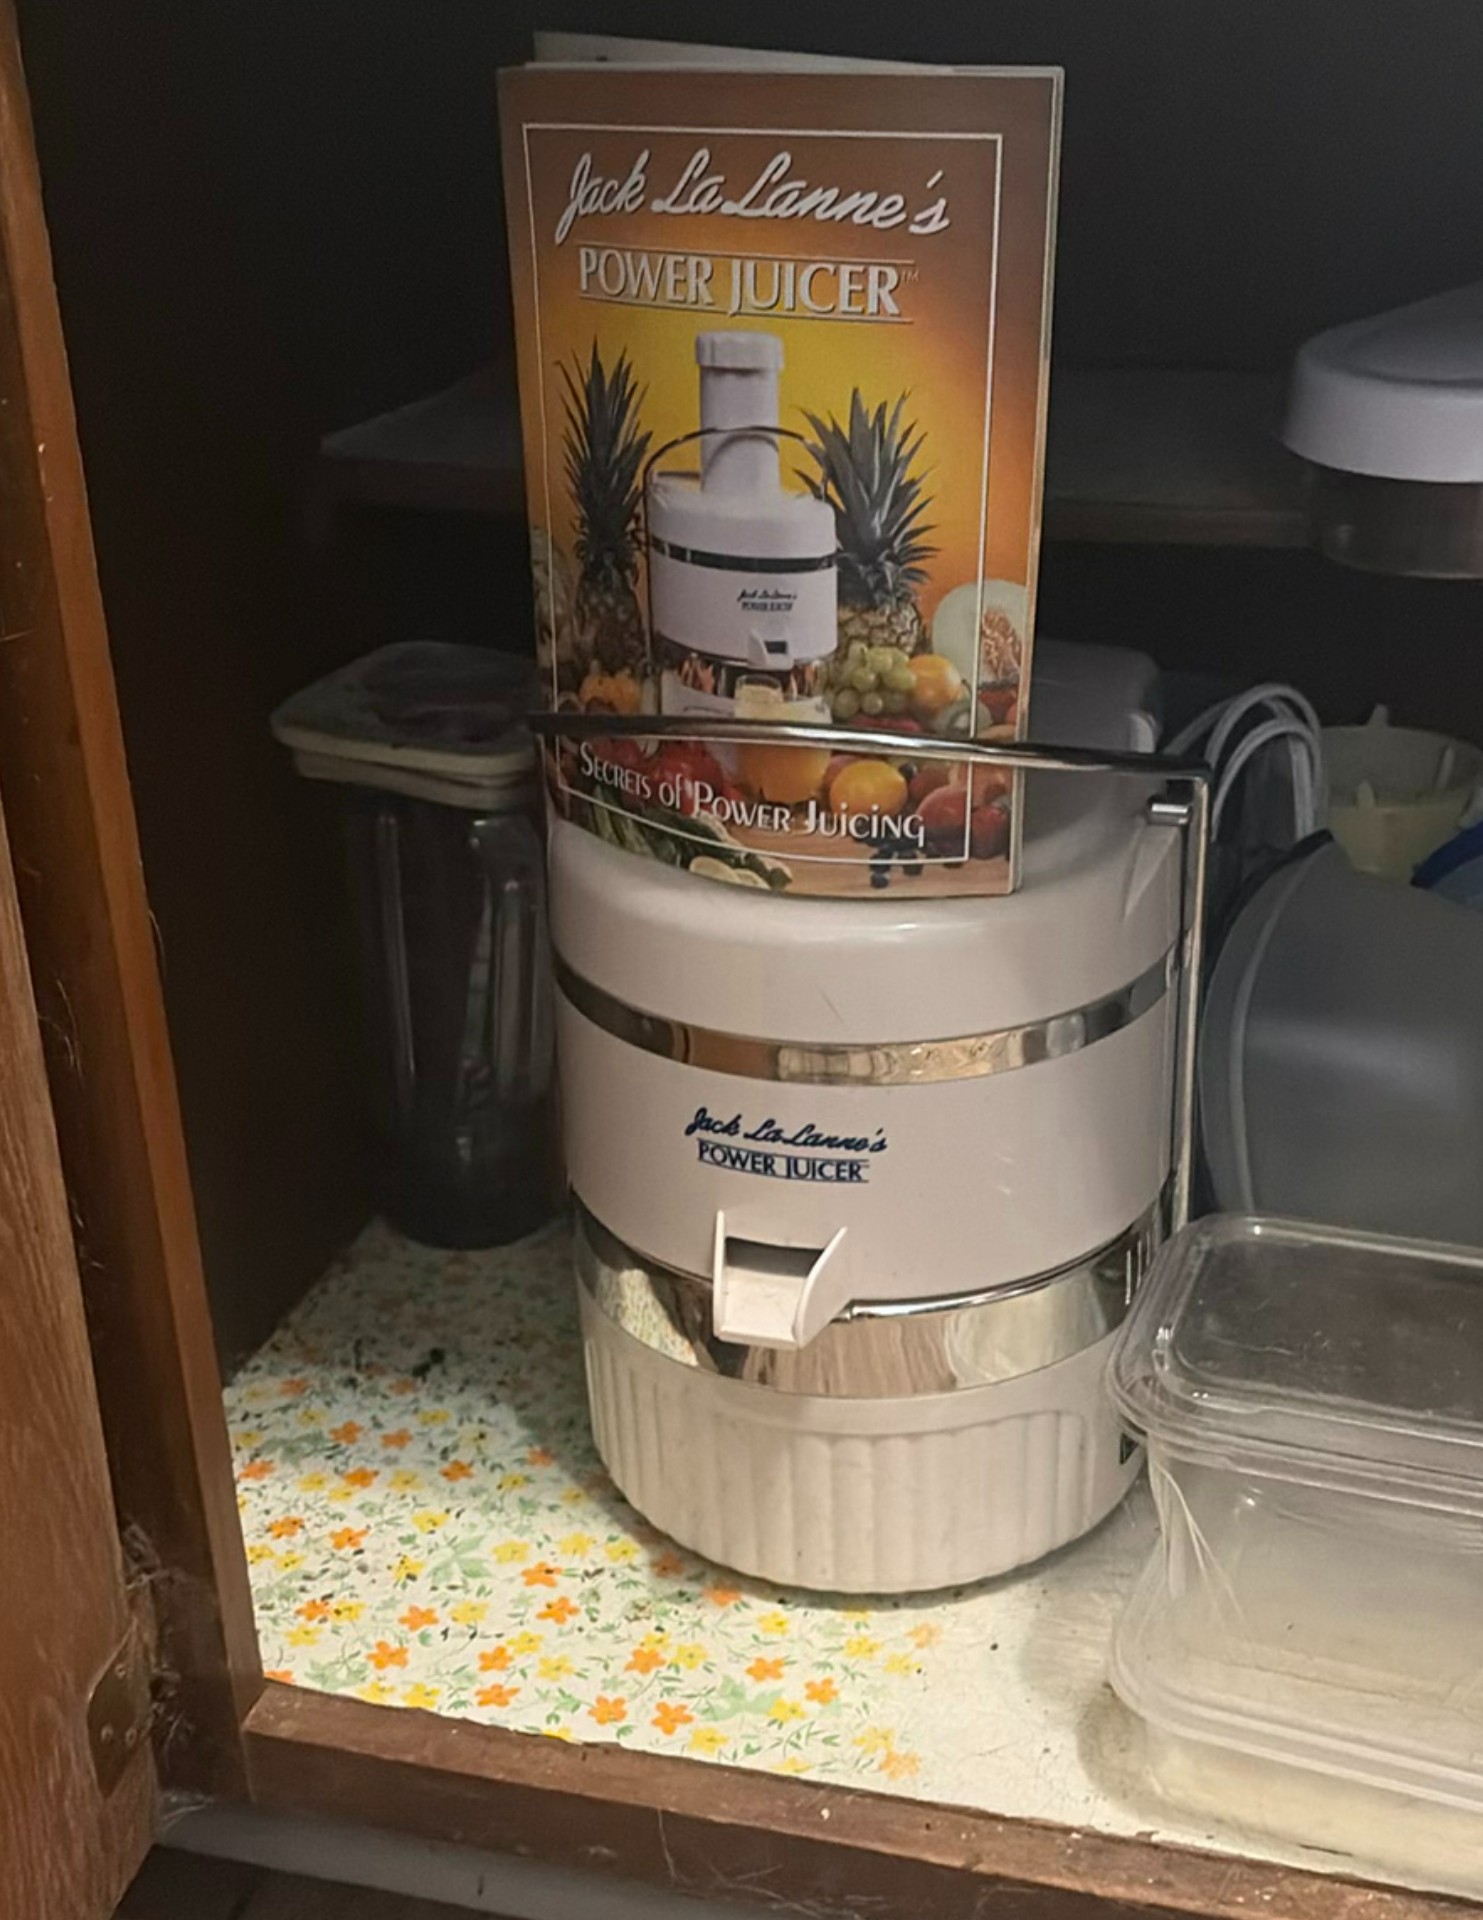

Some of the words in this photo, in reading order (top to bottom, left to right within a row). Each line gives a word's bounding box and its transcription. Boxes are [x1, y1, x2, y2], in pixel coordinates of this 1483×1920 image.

[554, 148, 650, 246] Jack
[578, 247, 715, 307] POWER
[658, 773, 684, 810] of
[684, 1106, 743, 1137] Jack
[698, 1141, 777, 1176] POWER
